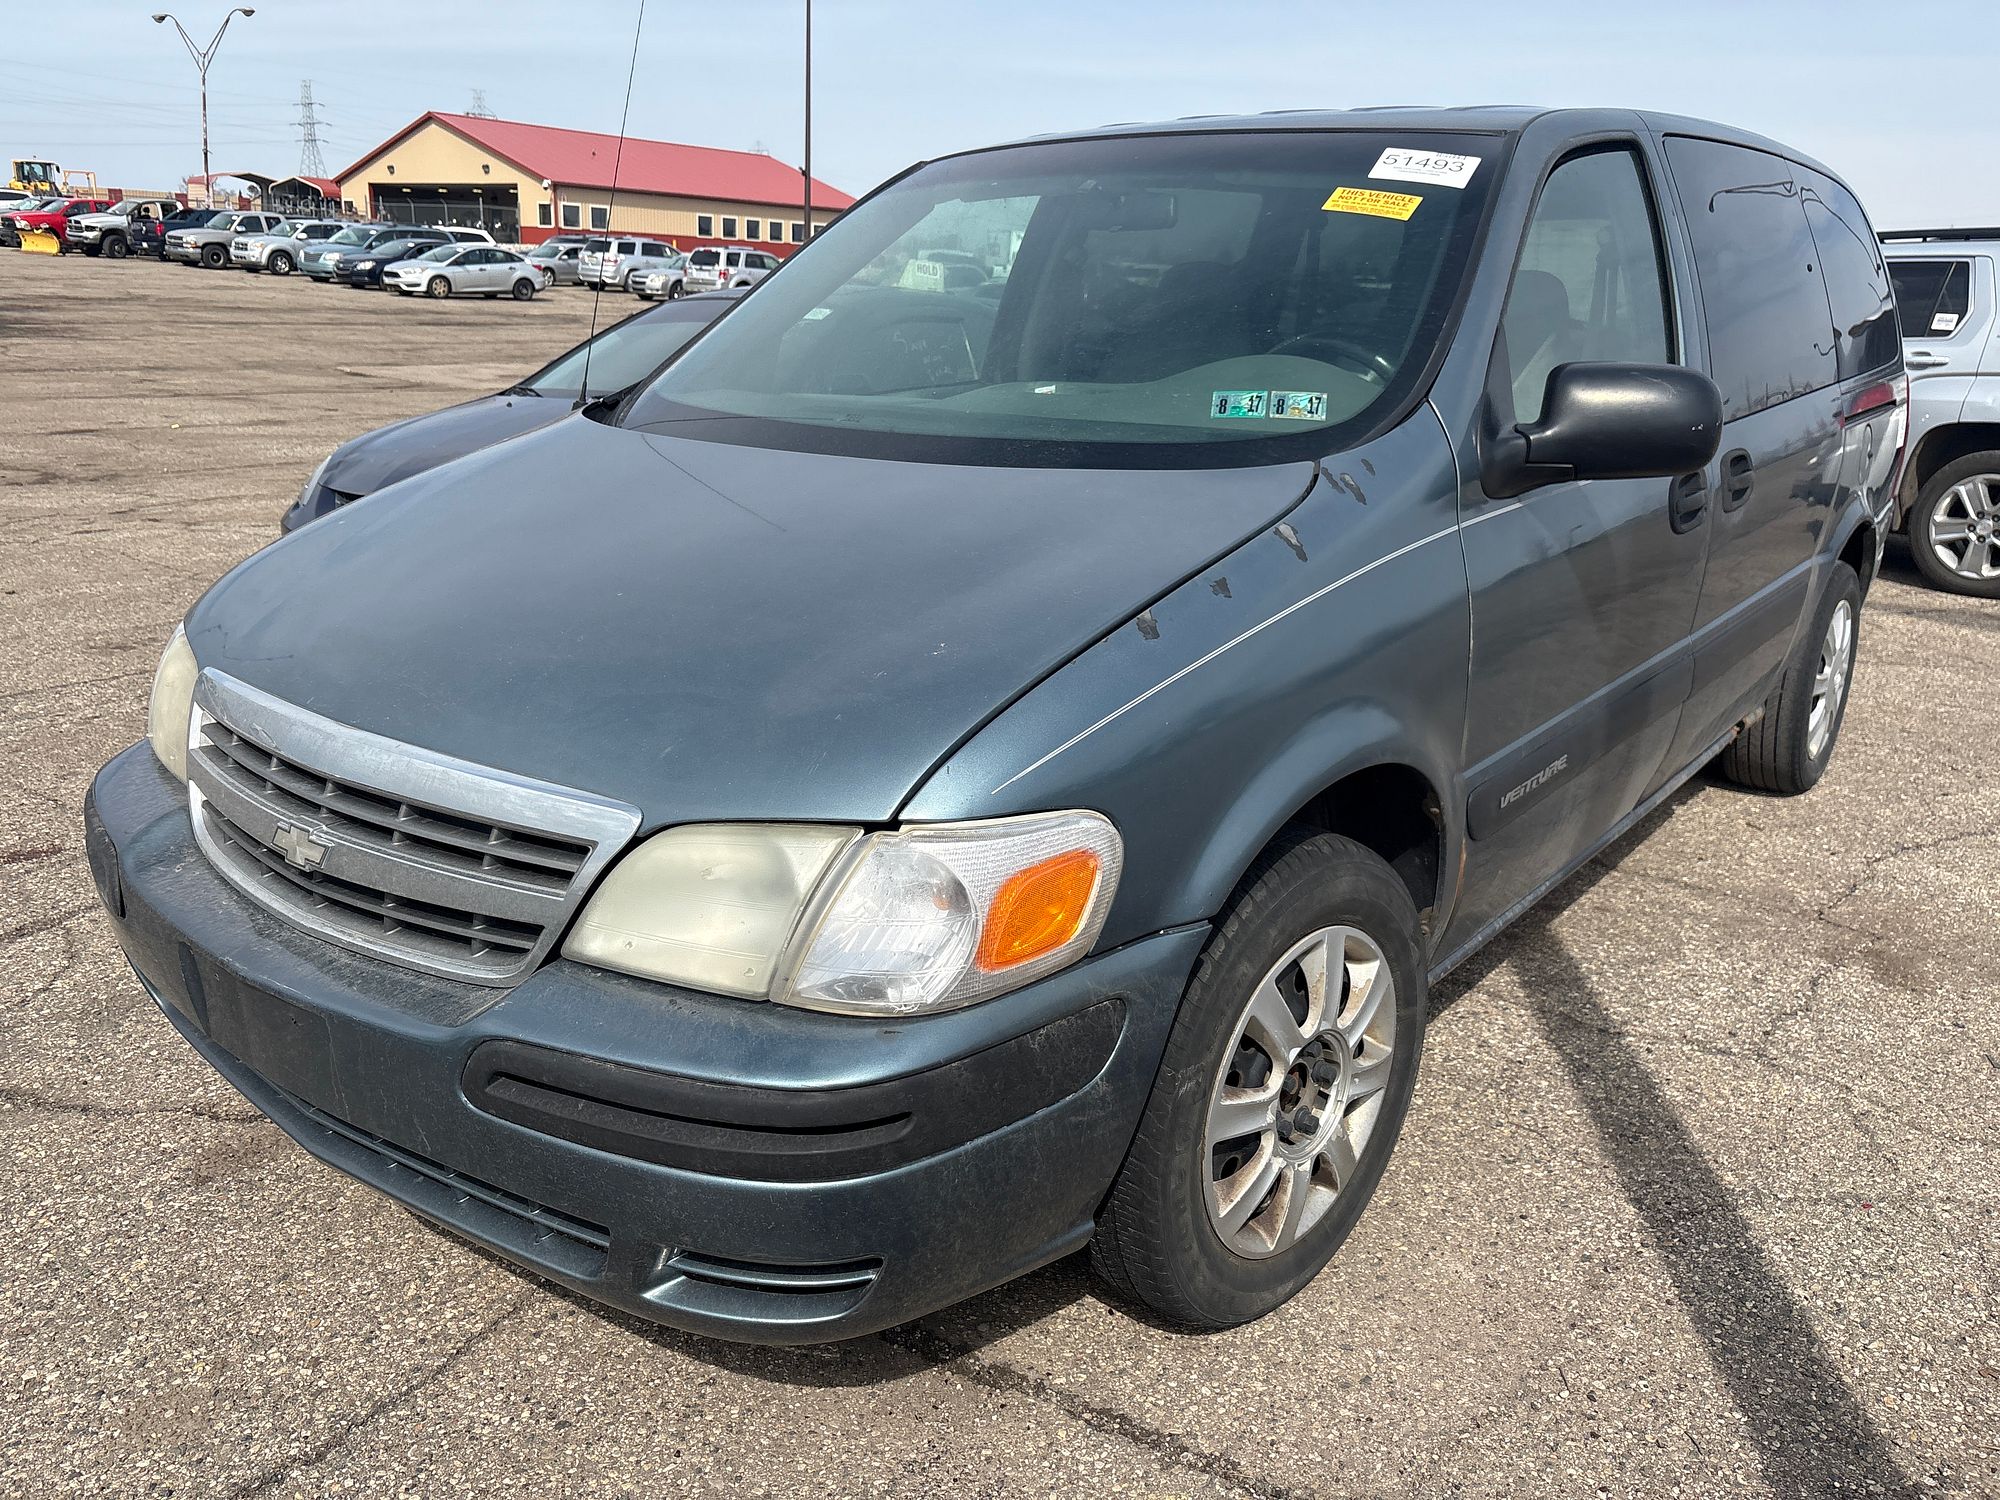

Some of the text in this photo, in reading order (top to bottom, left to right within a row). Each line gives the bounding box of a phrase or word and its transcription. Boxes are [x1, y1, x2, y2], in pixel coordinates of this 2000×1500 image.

[1383, 154, 1465, 173] 51493
[1340, 188, 1416, 204] THIS VEHICLE
[1383, 200, 1410, 208] SALE
[916, 263, 938, 276] HOLD
[1218, 395, 1263, 414] 8 17
[1276, 396, 1322, 415] 8 17
[1500, 753, 1568, 809] VENTURE
